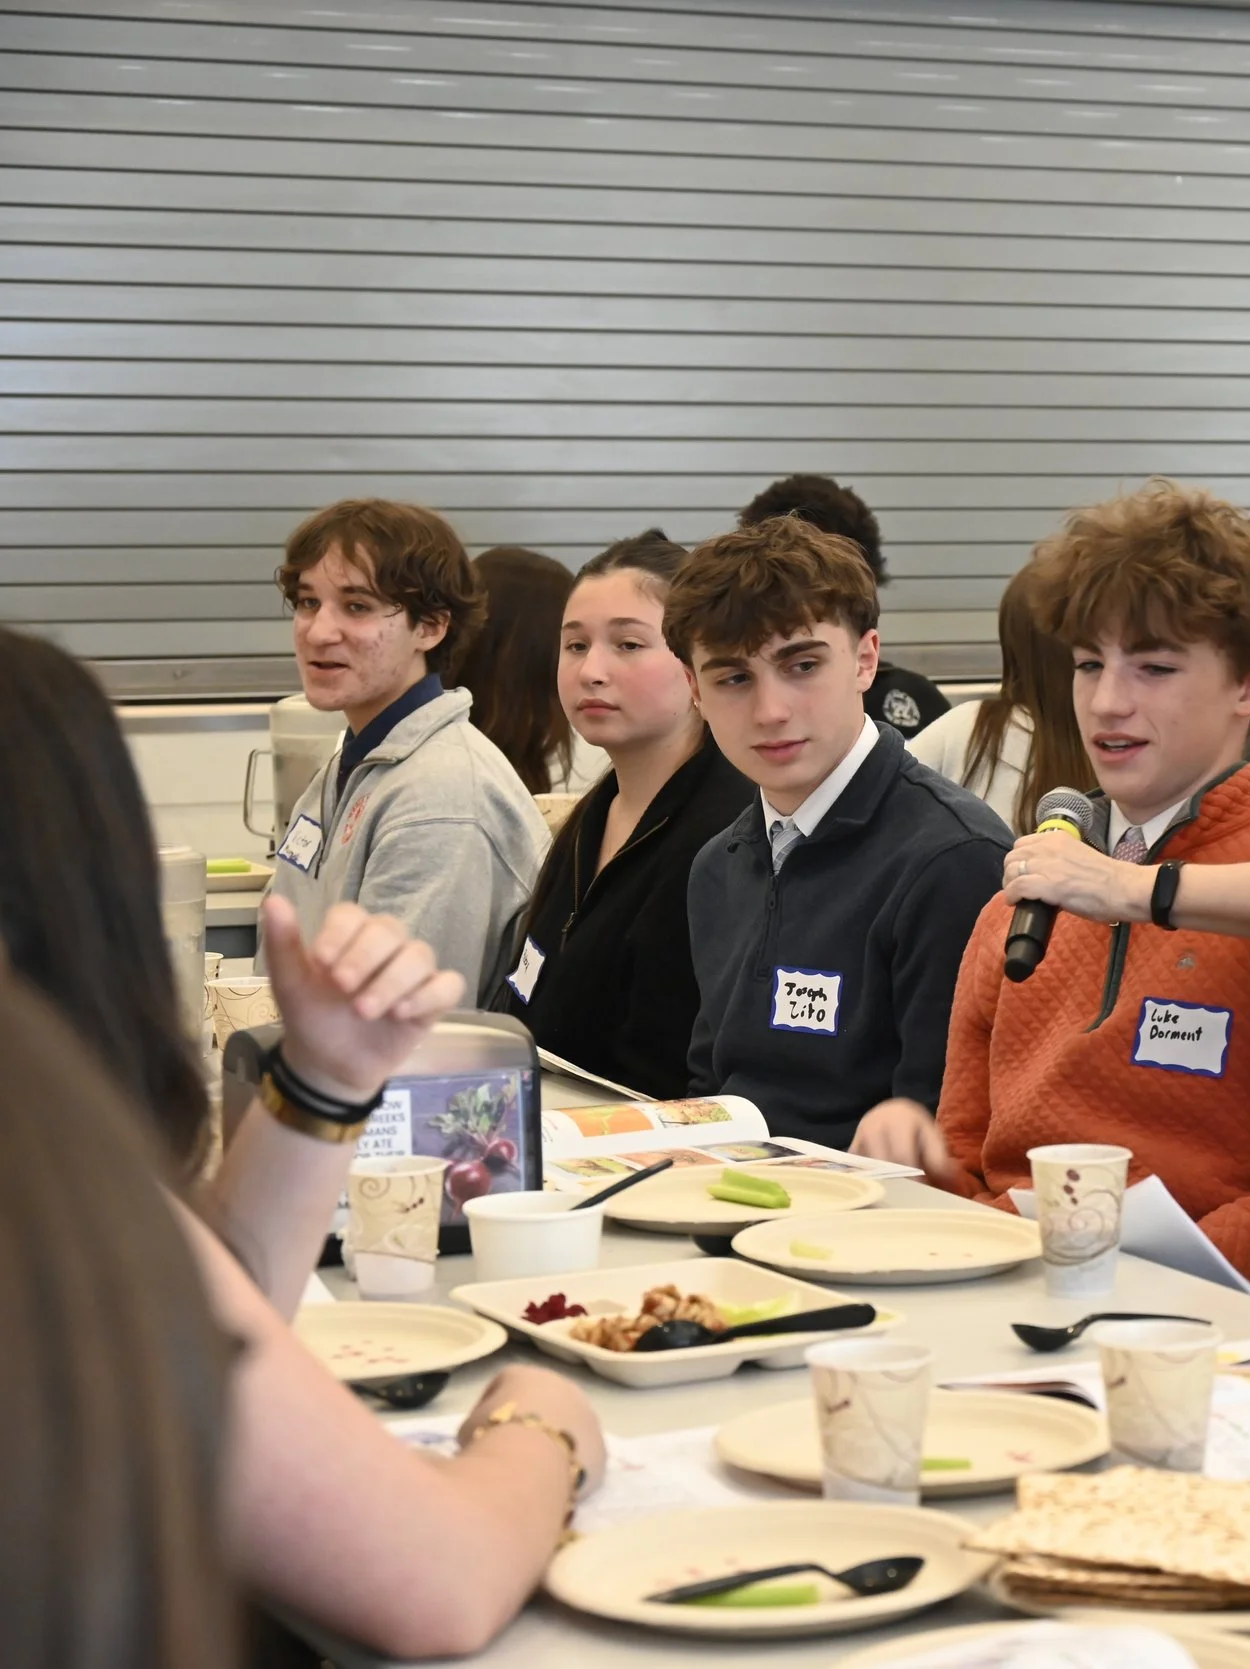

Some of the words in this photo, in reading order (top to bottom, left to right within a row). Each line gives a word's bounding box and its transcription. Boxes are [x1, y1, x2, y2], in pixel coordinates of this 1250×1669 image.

[789, 1001, 826, 1022] Zito
[1150, 1008, 1180, 1024] Luke
[1149, 1024, 1203, 1042] Dorment
